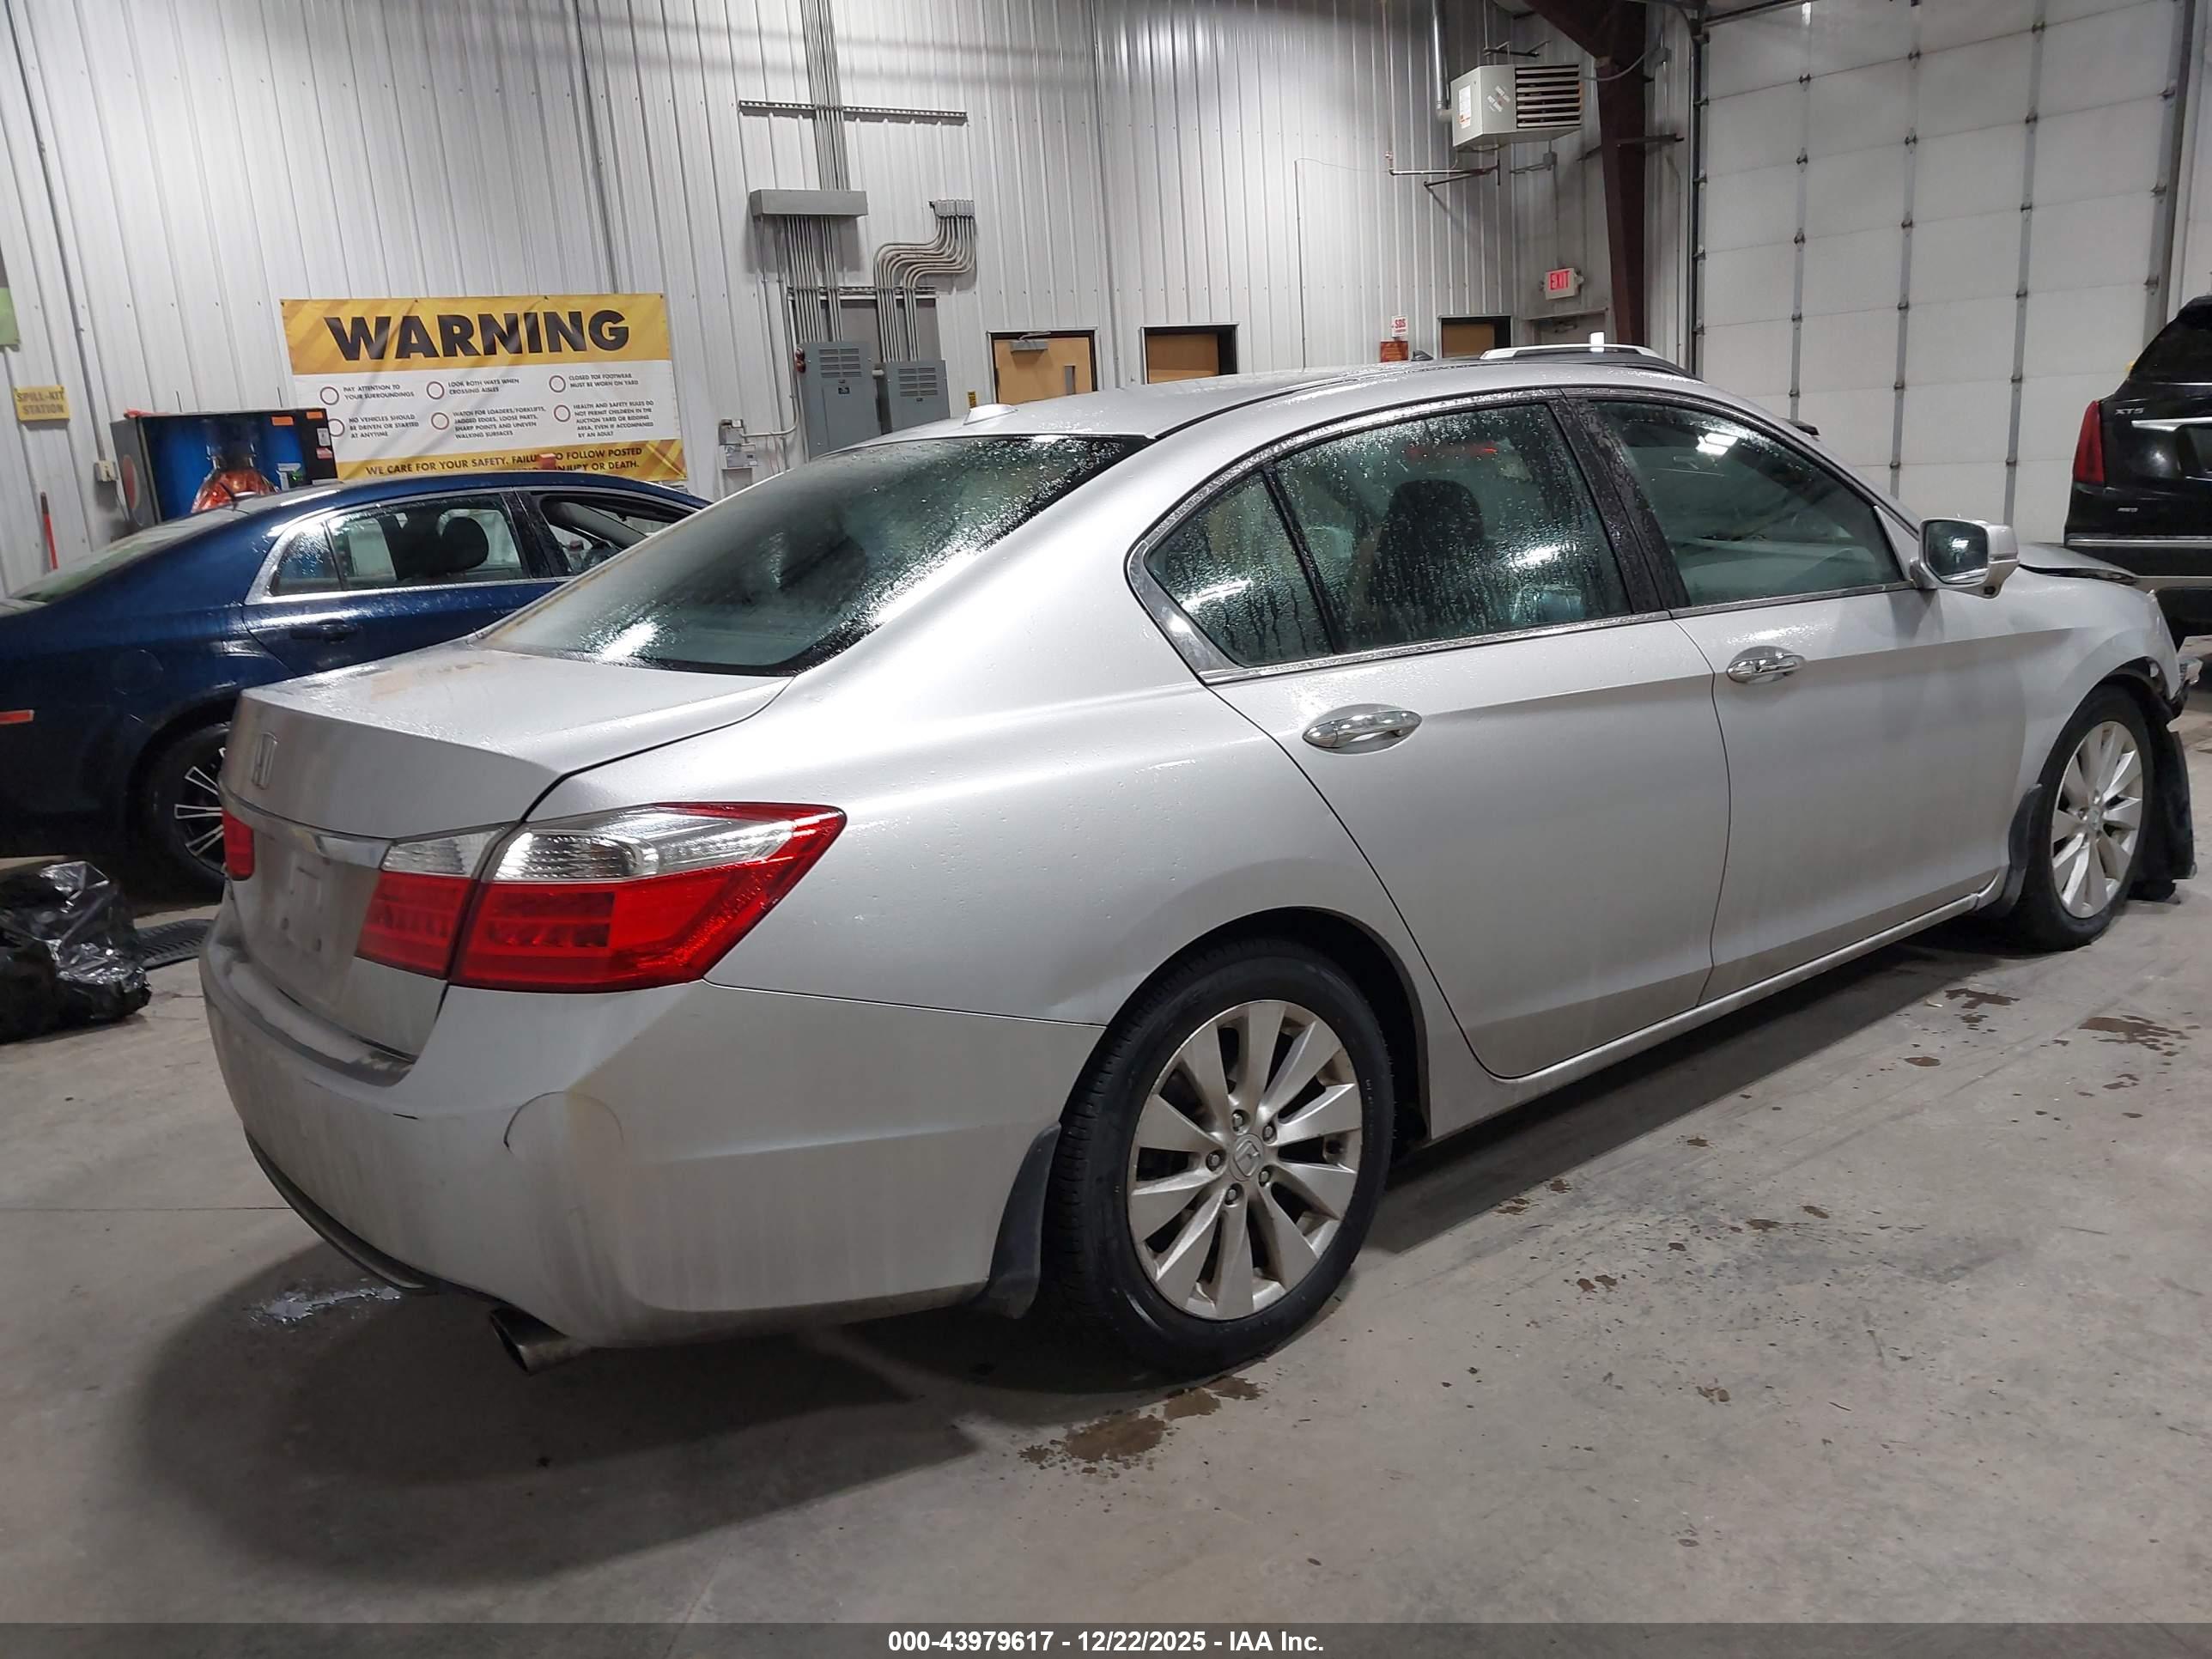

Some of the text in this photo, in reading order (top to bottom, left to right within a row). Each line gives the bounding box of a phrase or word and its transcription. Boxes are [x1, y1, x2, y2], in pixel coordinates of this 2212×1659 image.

[1550, 270, 1569, 290] EXIT
[324, 310, 629, 361] WARNING
[22, 404, 64, 415] STATION
[366, 466, 383, 475] WE
[387, 464, 413, 474] CARE
[416, 462, 436, 471] FOR
[439, 460, 469, 469] YOUR
[567, 450, 605, 460] FOLLOW
[608, 448, 642, 457] POSTED
[591, 462, 605, 471] OR
[608, 460, 639, 469] DEATH.
